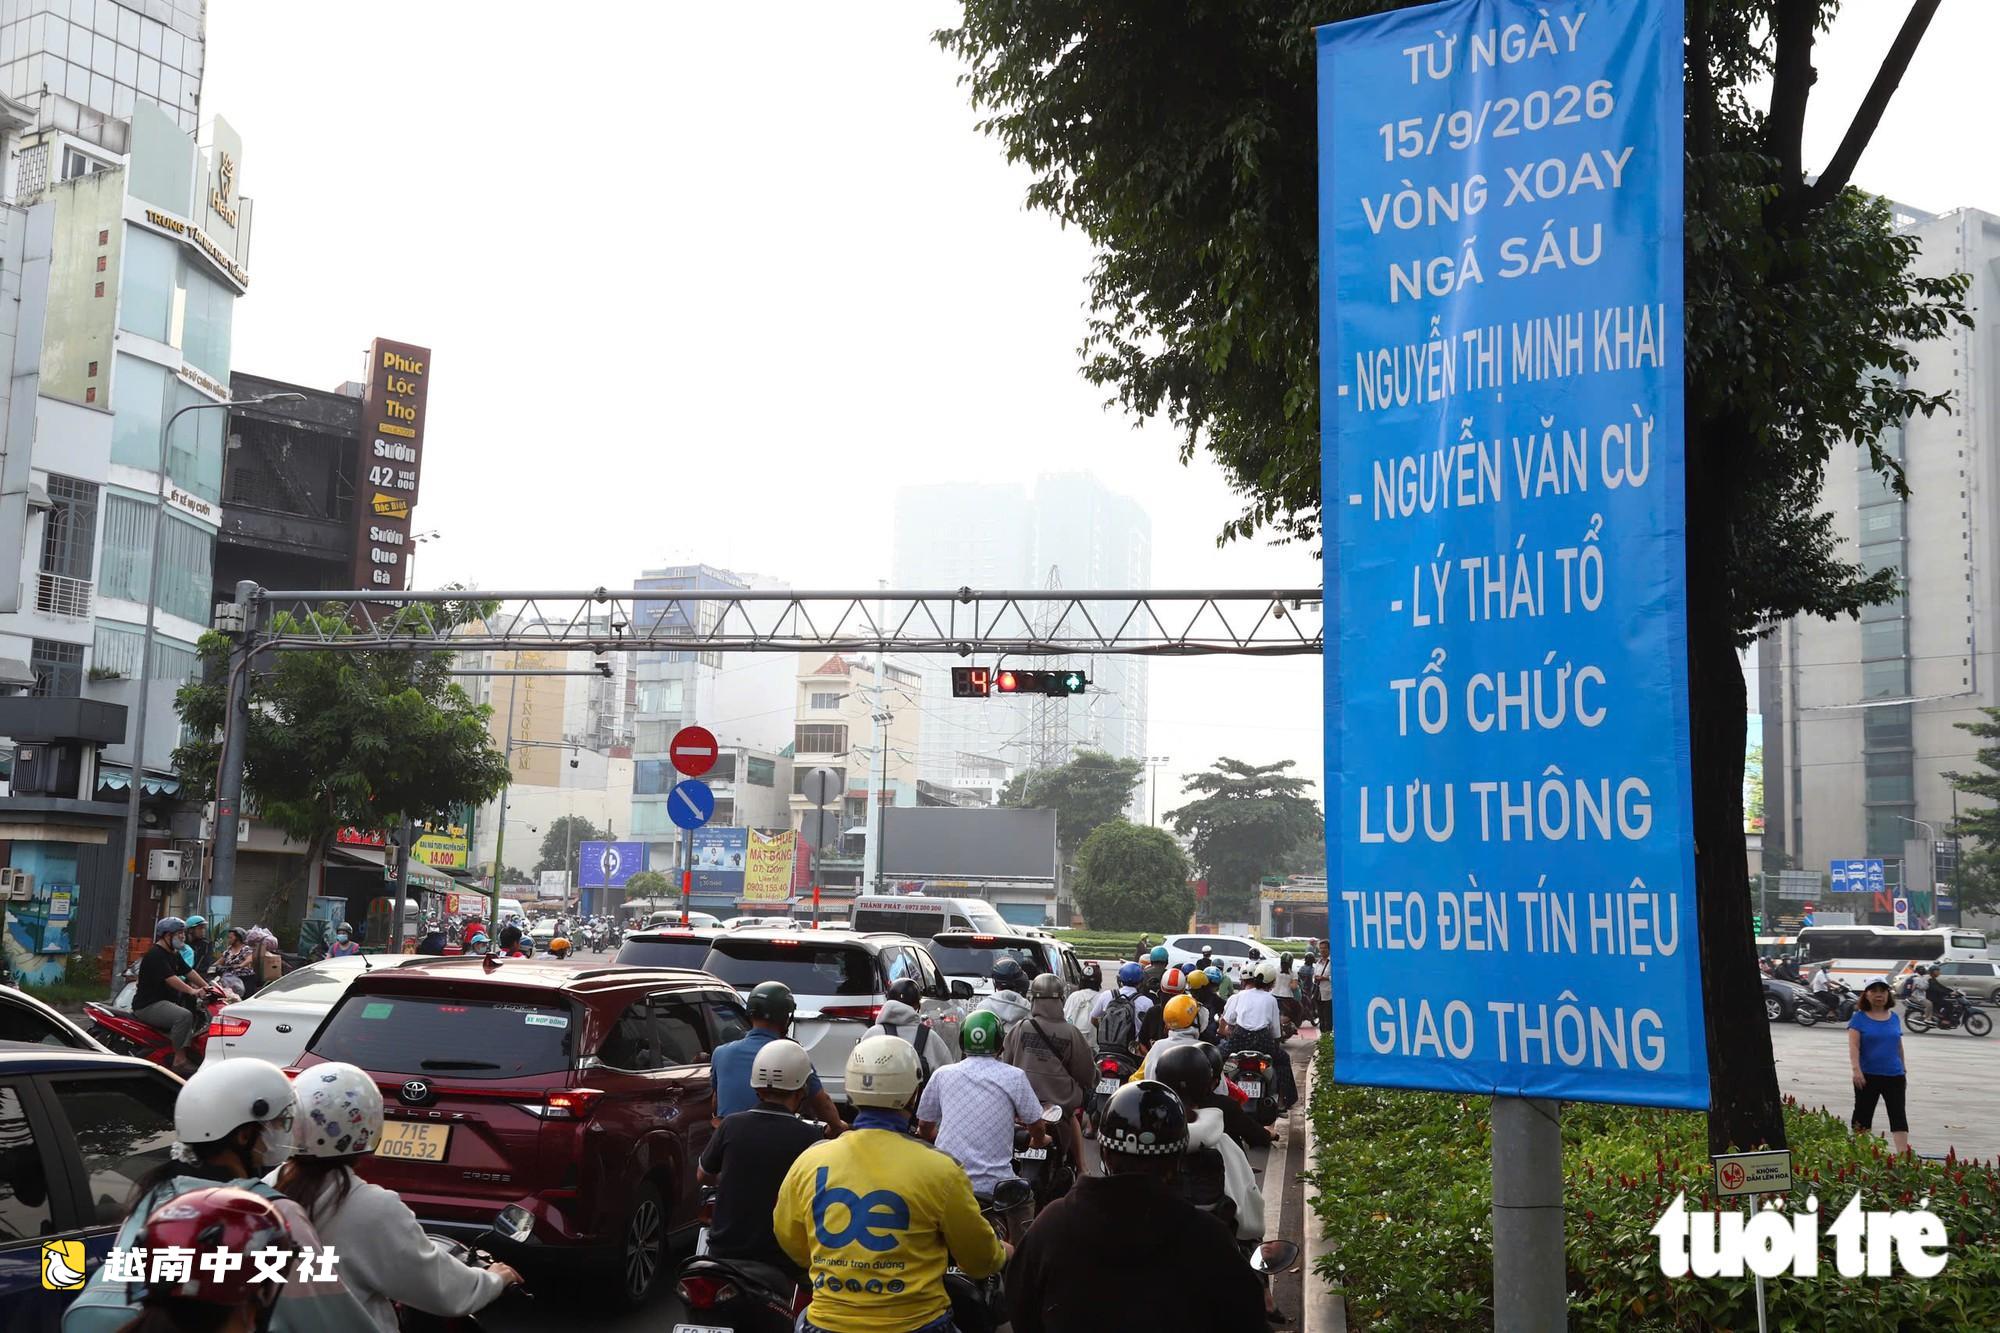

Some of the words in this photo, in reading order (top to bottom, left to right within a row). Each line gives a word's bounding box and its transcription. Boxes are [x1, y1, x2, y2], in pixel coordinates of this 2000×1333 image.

[1403, 31, 1457, 84] TỪ
[1472, 9, 1586, 73] NGÀY
[1380, 80, 1614, 162] 15/9/2026
[1361, 174, 1488, 234] VÒNG
[1503, 147, 1634, 206] XOAY
[145, 208, 185, 234] TRUNG
[1390, 235, 1484, 303] NGÃ
[1499, 219, 1602, 278] SÁU
[383, 351, 424, 375] Phúc
[1356, 315, 1457, 411] NGUYỄN
[1463, 324, 1502, 402] THỊ
[1513, 312, 1583, 384] MINH
[1594, 303, 1664, 373] KHAI
[387, 375, 416, 398] Lộc
[386, 399, 416, 425] Thọ
[374, 439, 416, 463] Sườn
[1373, 416, 1501, 520] NGUYỄN
[1513, 415, 1588, 499] VĂN
[1601, 404, 1654, 489] CỪ
[370, 526, 404, 545] Sườn
[371, 547, 398, 564] Que
[373, 569, 391, 584] Gà
[1413, 543, 1451, 627] LÝ
[1461, 534, 1545, 621] THÁI
[1556, 513, 1604, 614] TỔ
[971, 671, 987, 693] 4
[1391, 647, 1448, 736] TỔ
[1466, 651, 1607, 733] CHỨC
[519, 676, 535, 769] KINGDOM
[1360, 778, 1455, 843] LƯU
[1470, 764, 1652, 841] THÔNG
[430, 851, 454, 865] 14.000
[1342, 891, 1427, 950] THEO
[1437, 874, 1509, 952] ĐÈN
[1517, 874, 1577, 954] TÍN
[1589, 877, 1679, 972] HIỆU
[1367, 997, 1474, 1059] GIAO
[1487, 990, 1665, 1071] THÔNG
[384, 1107, 464, 1119] ELOZ
[400, 1124, 430, 1140] 71E
[383, 1139, 437, 1158] 005.32
[463, 1171, 511, 1182] CROSS
[812, 1166, 910, 1252] be
